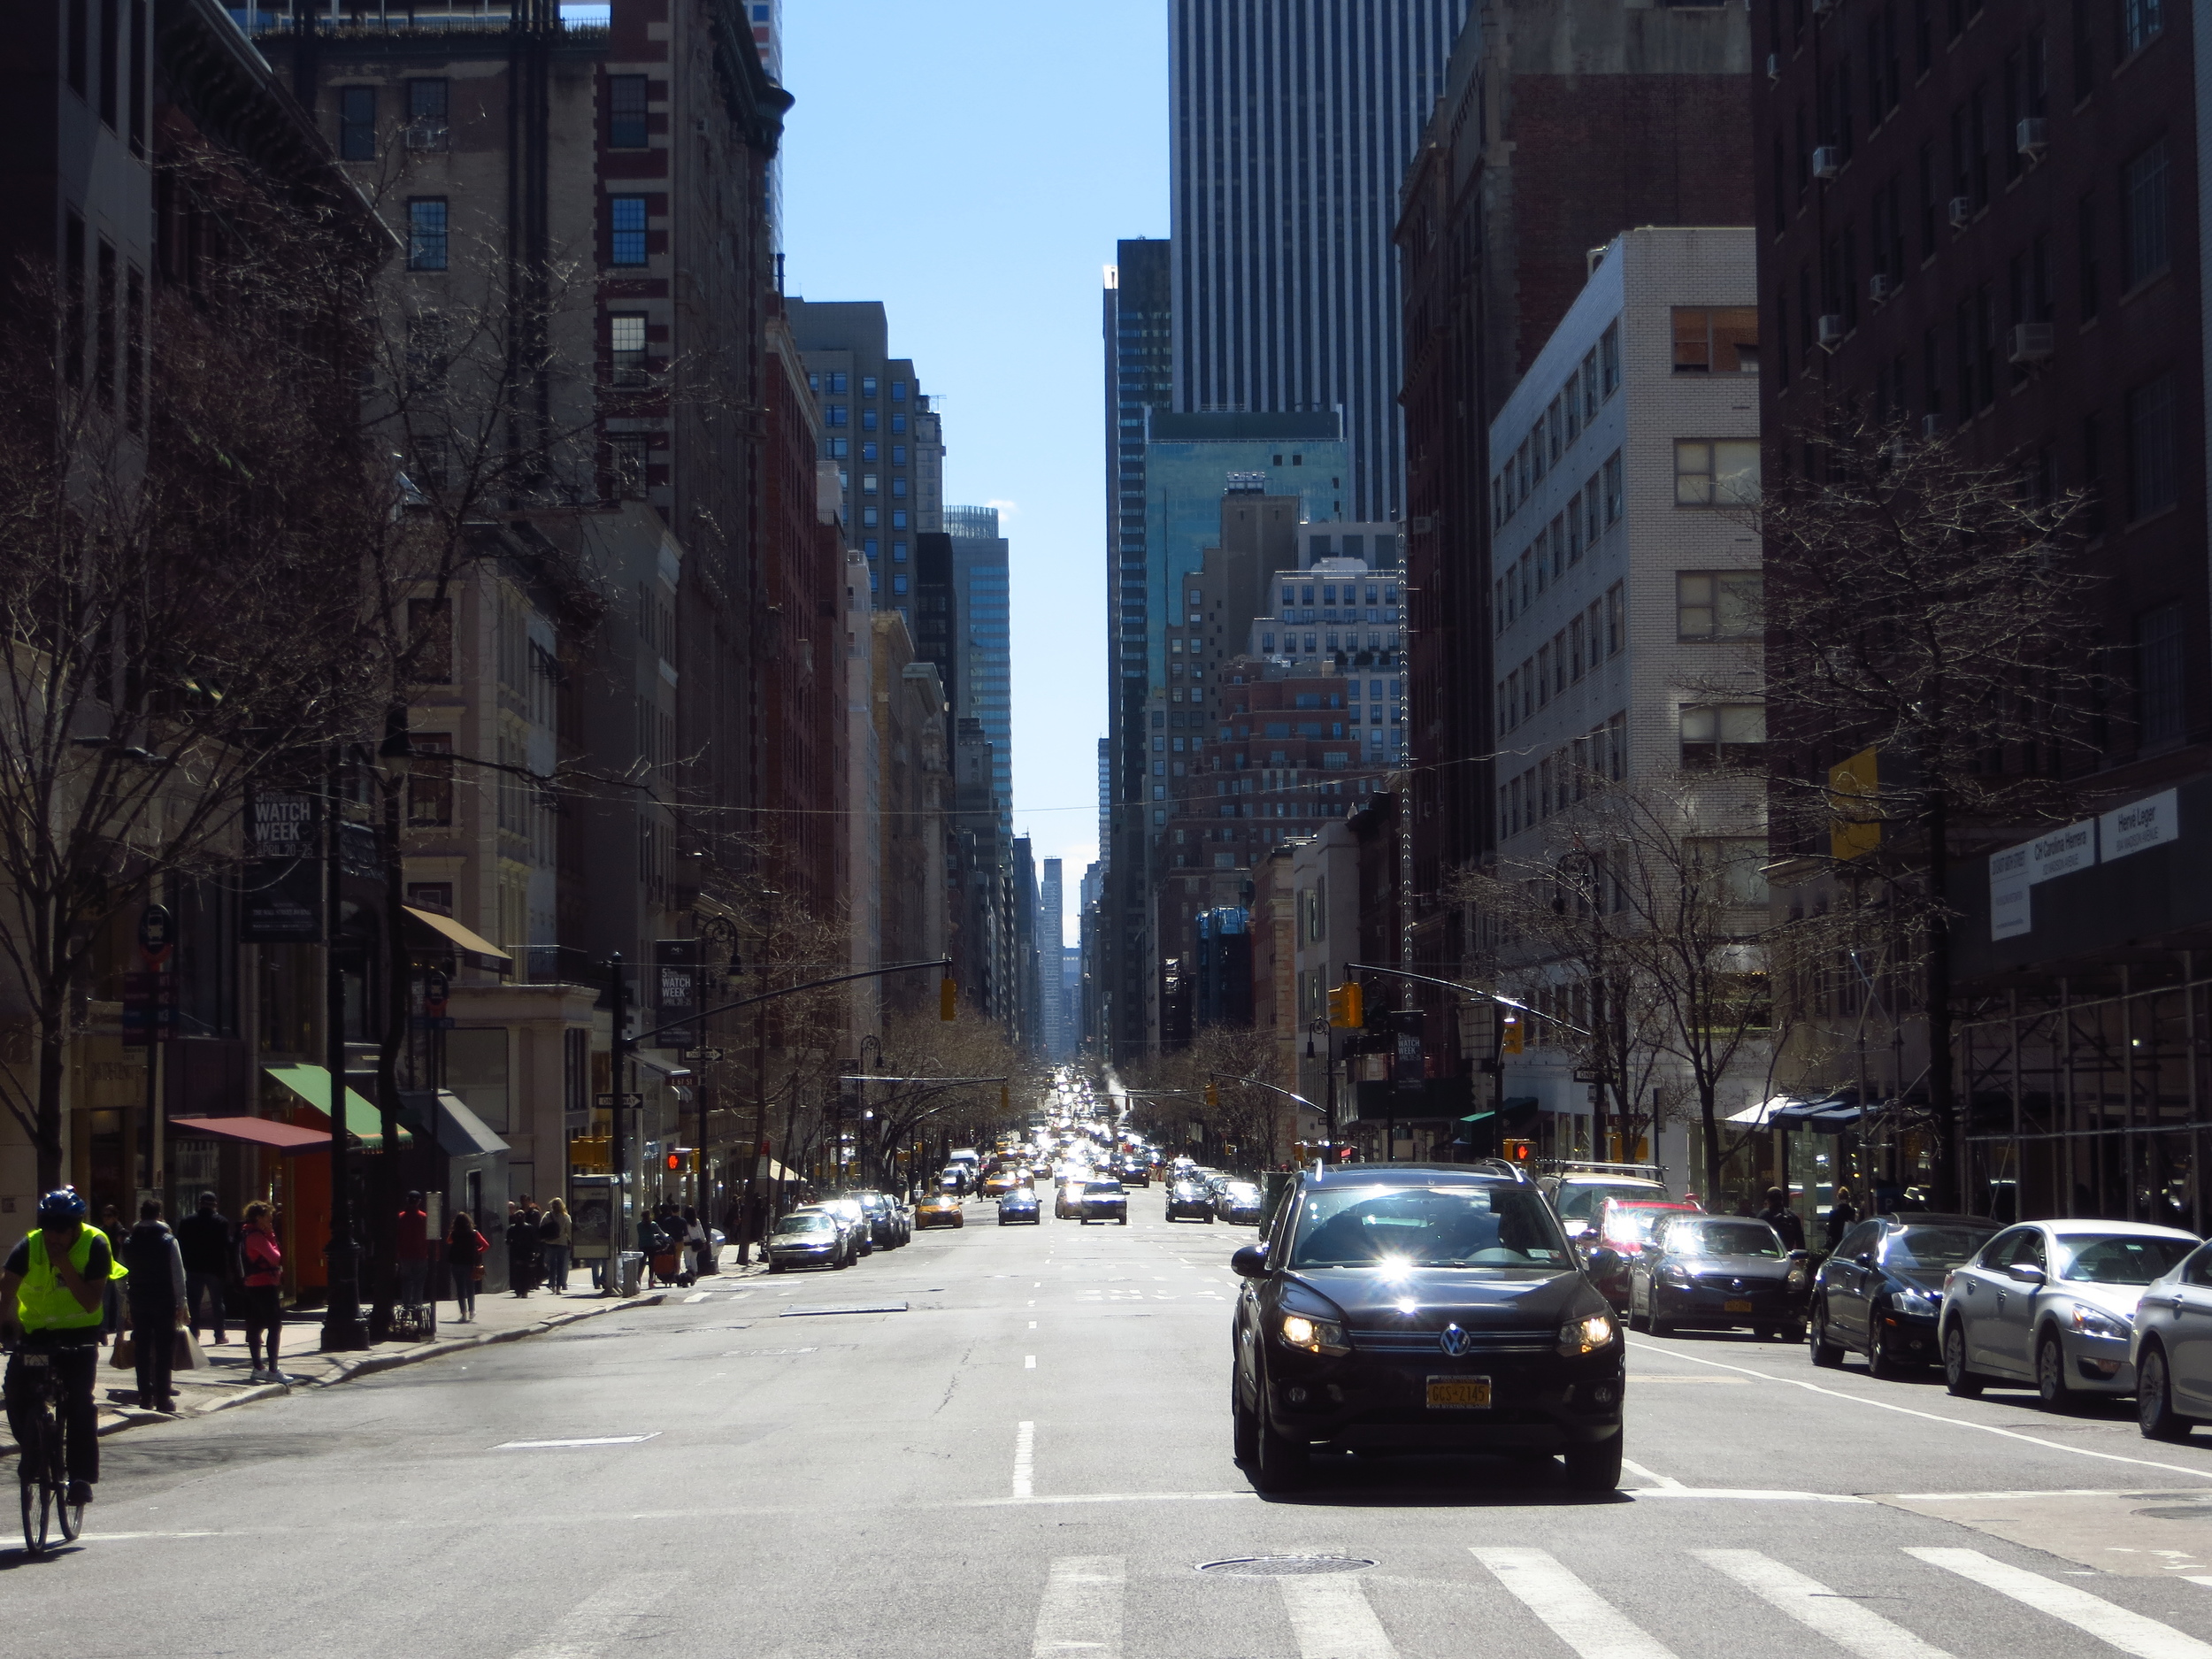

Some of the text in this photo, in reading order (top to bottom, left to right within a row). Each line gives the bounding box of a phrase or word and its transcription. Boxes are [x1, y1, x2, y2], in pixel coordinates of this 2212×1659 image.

[255, 803, 311, 822] WATCH
[2137, 806, 2155, 828] Leger
[255, 822, 300, 841] WEEK
[257, 843, 280, 857] APRIL
[2044, 836, 2064, 858] Carolina
[2065, 831, 2086, 850] Herrera
[662, 977, 690, 987] WATCH
[662, 987, 686, 997] WEEK
[1398, 1039, 1420, 1048] WATCH
